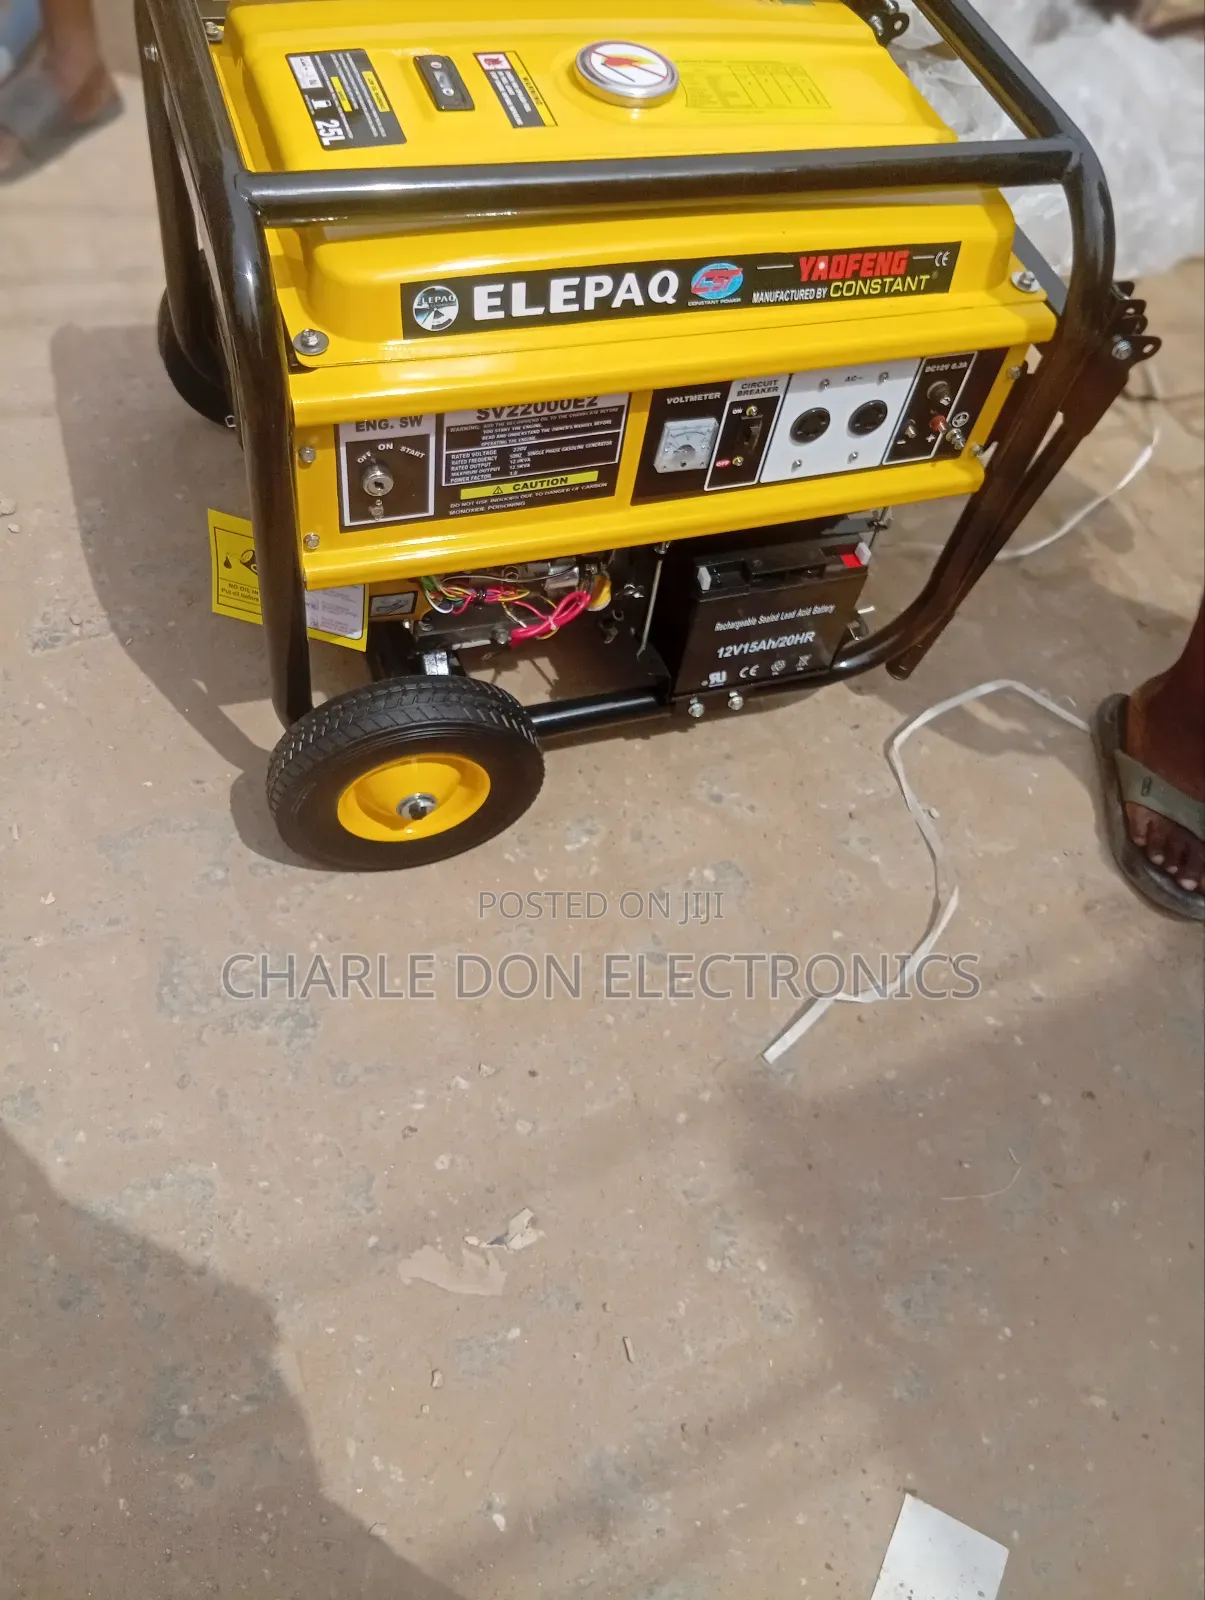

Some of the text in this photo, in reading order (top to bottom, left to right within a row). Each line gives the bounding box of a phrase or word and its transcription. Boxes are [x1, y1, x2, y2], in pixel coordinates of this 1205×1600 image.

[315, 119, 346, 146] 25L
[800, 251, 910, 282] YAOFENG
[830, 275, 930, 298] CONSTANT
[473, 270, 679, 321] ELEPAQ
[752, 287, 828, 304] MANUFACTURED BY
[737, 386, 780, 397] BREAKER
[741, 380, 779, 390] CIRCUIT
[666, 392, 722, 405] VOLTMETER
[476, 396, 598, 421] SV22000E2
[355, 415, 423, 433] ENG. SW
[378, 442, 393, 451] ON
[400, 445, 426, 459] START
[471, 449, 497, 458] VOLTAGE
[357, 450, 372, 464] OFF
[513, 477, 568, 491] CAUTION
[449, 501, 526, 516] MONOXIDE POISONING
[239, 586, 251, 594] OIL
[714, 604, 836, 631] Rechargeable Sealed Lead Acid Battery
[717, 631, 816, 659] 12V15Ah/20HR
